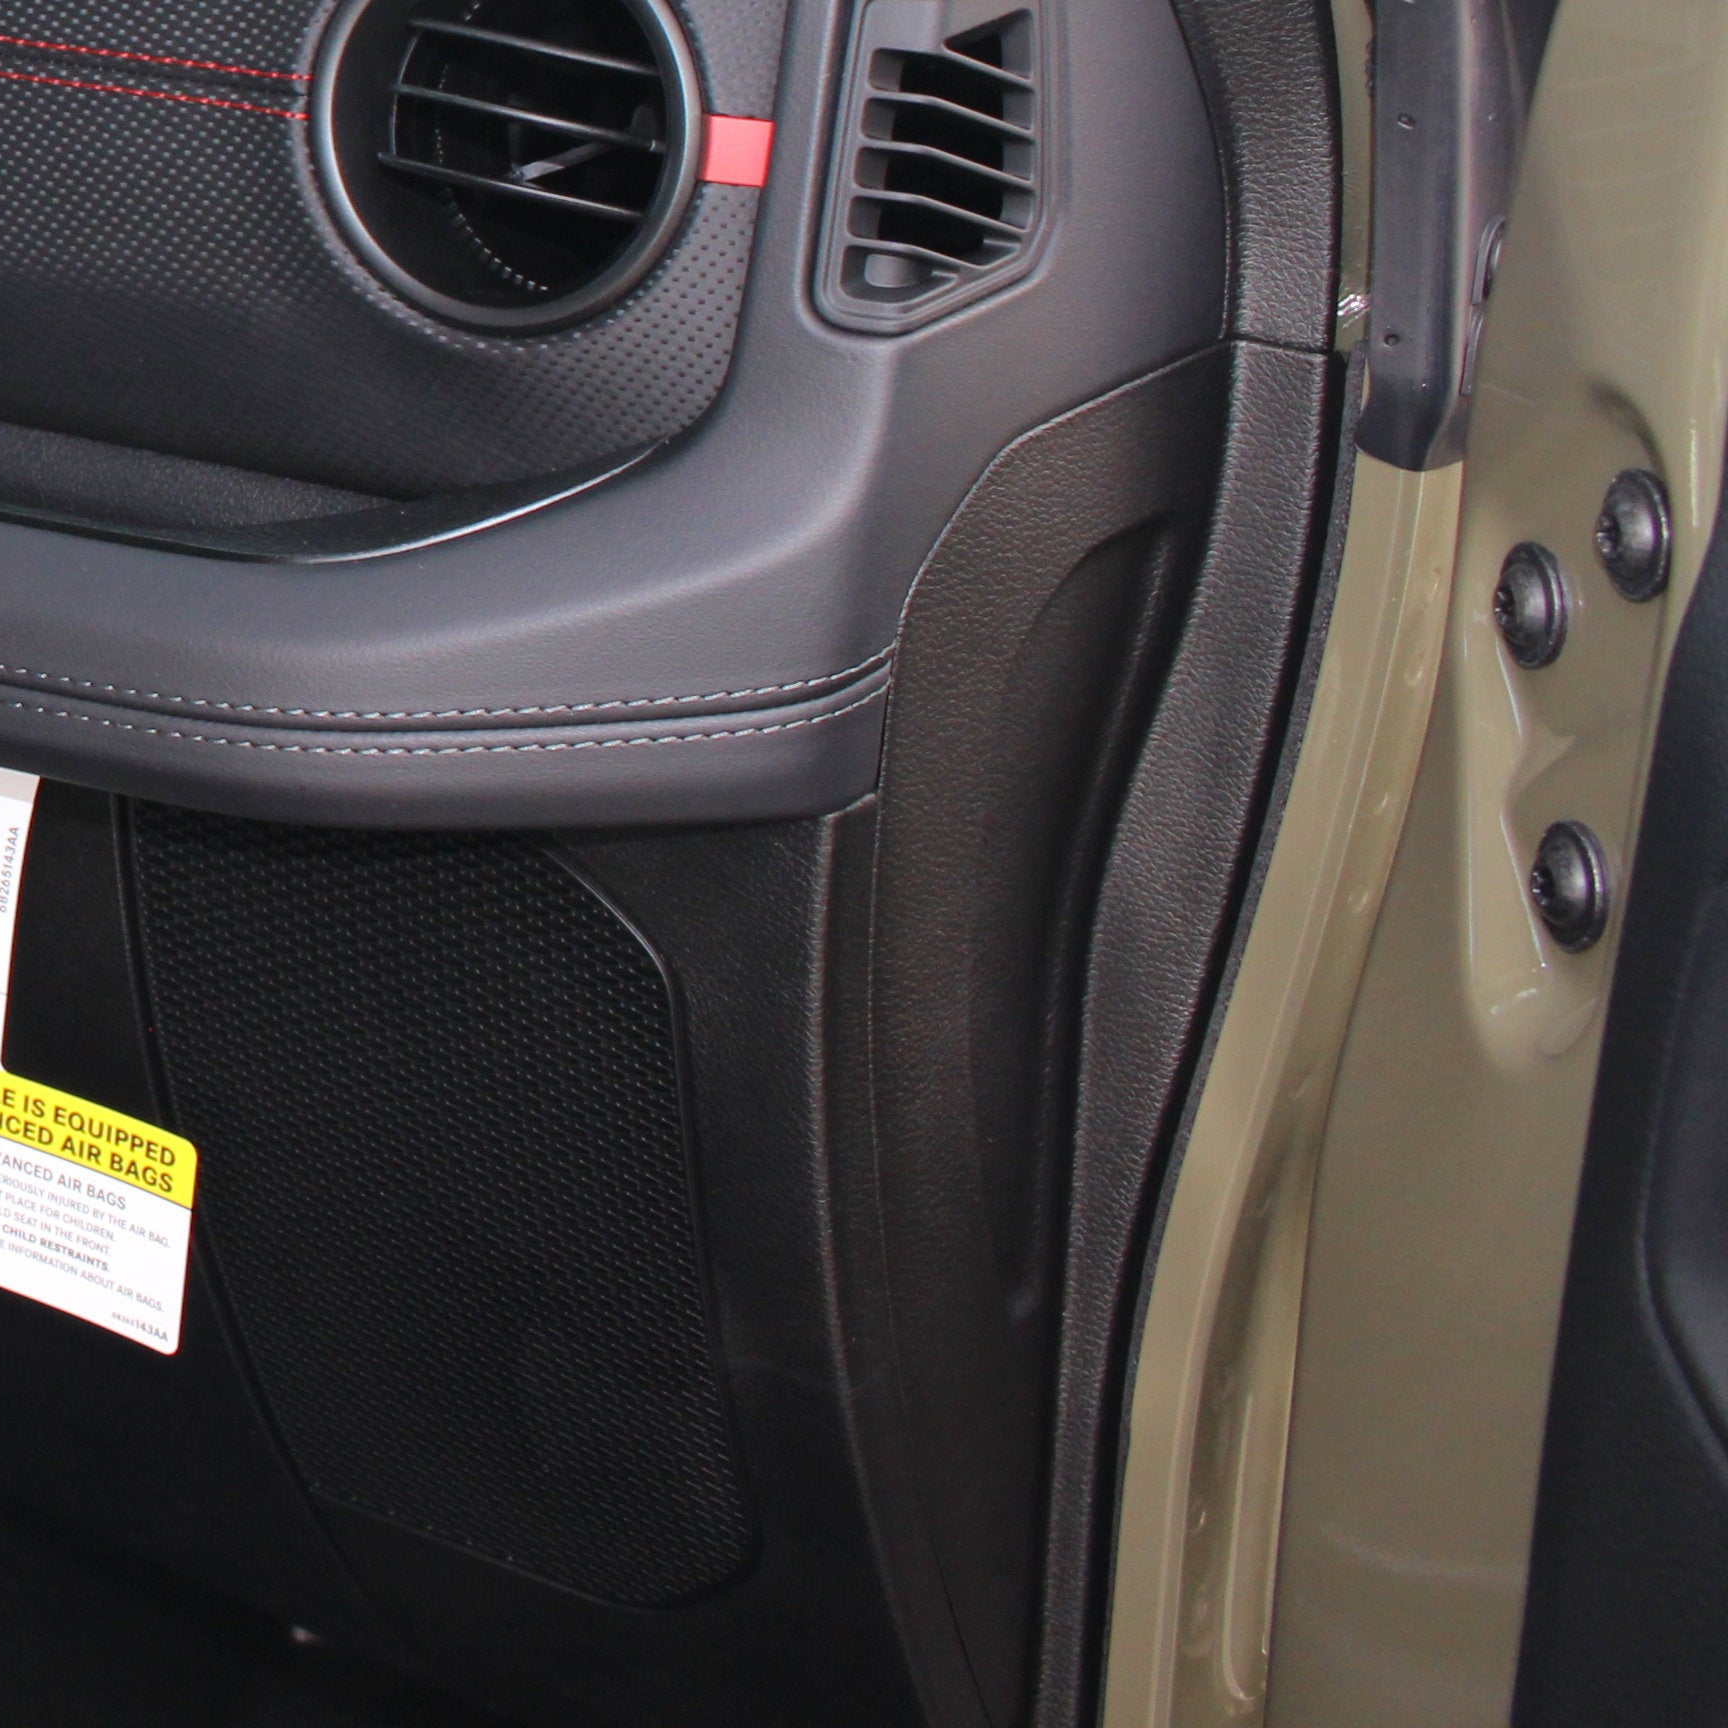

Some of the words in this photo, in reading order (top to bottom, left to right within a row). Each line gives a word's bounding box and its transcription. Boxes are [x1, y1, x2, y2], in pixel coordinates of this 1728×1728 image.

[24, 1096, 44, 1118] IS
[53, 1107, 175, 1167] EQUIPPED
[62, 1134, 101, 1164] AIR
[110, 1152, 173, 1193] BAGS
[5, 1193, 36, 1211] PLACE
[40, 1205, 59, 1219] FOR
[63, 1213, 116, 1241] CHILDREN.
[58, 1173, 80, 1192] AIR
[88, 1184, 125, 1210] BAGS
[14, 1212, 36, 1227] SEAT
[41, 1222, 50, 1233] IN
[55, 1227, 72, 1241] THE
[77, 1235, 111, 1256] FRONT.
[49, 1192, 88, 1214] INJURED
[93, 1208, 103, 1220] BY
[108, 1214, 126, 1229] THE
[129, 1223, 144, 1237] AIR
[149, 1231, 170, 1248] BAG.
[3, 1224, 35, 1243] CHILD
[40, 1238, 110, 1272] RESTRAINTS.
[8, 1242, 76, 1275] INFORMATION
[81, 1270, 113, 1290] ABOUT
[117, 1284, 132, 1298] AIR
[136, 1292, 163, 1311] BAGS.
